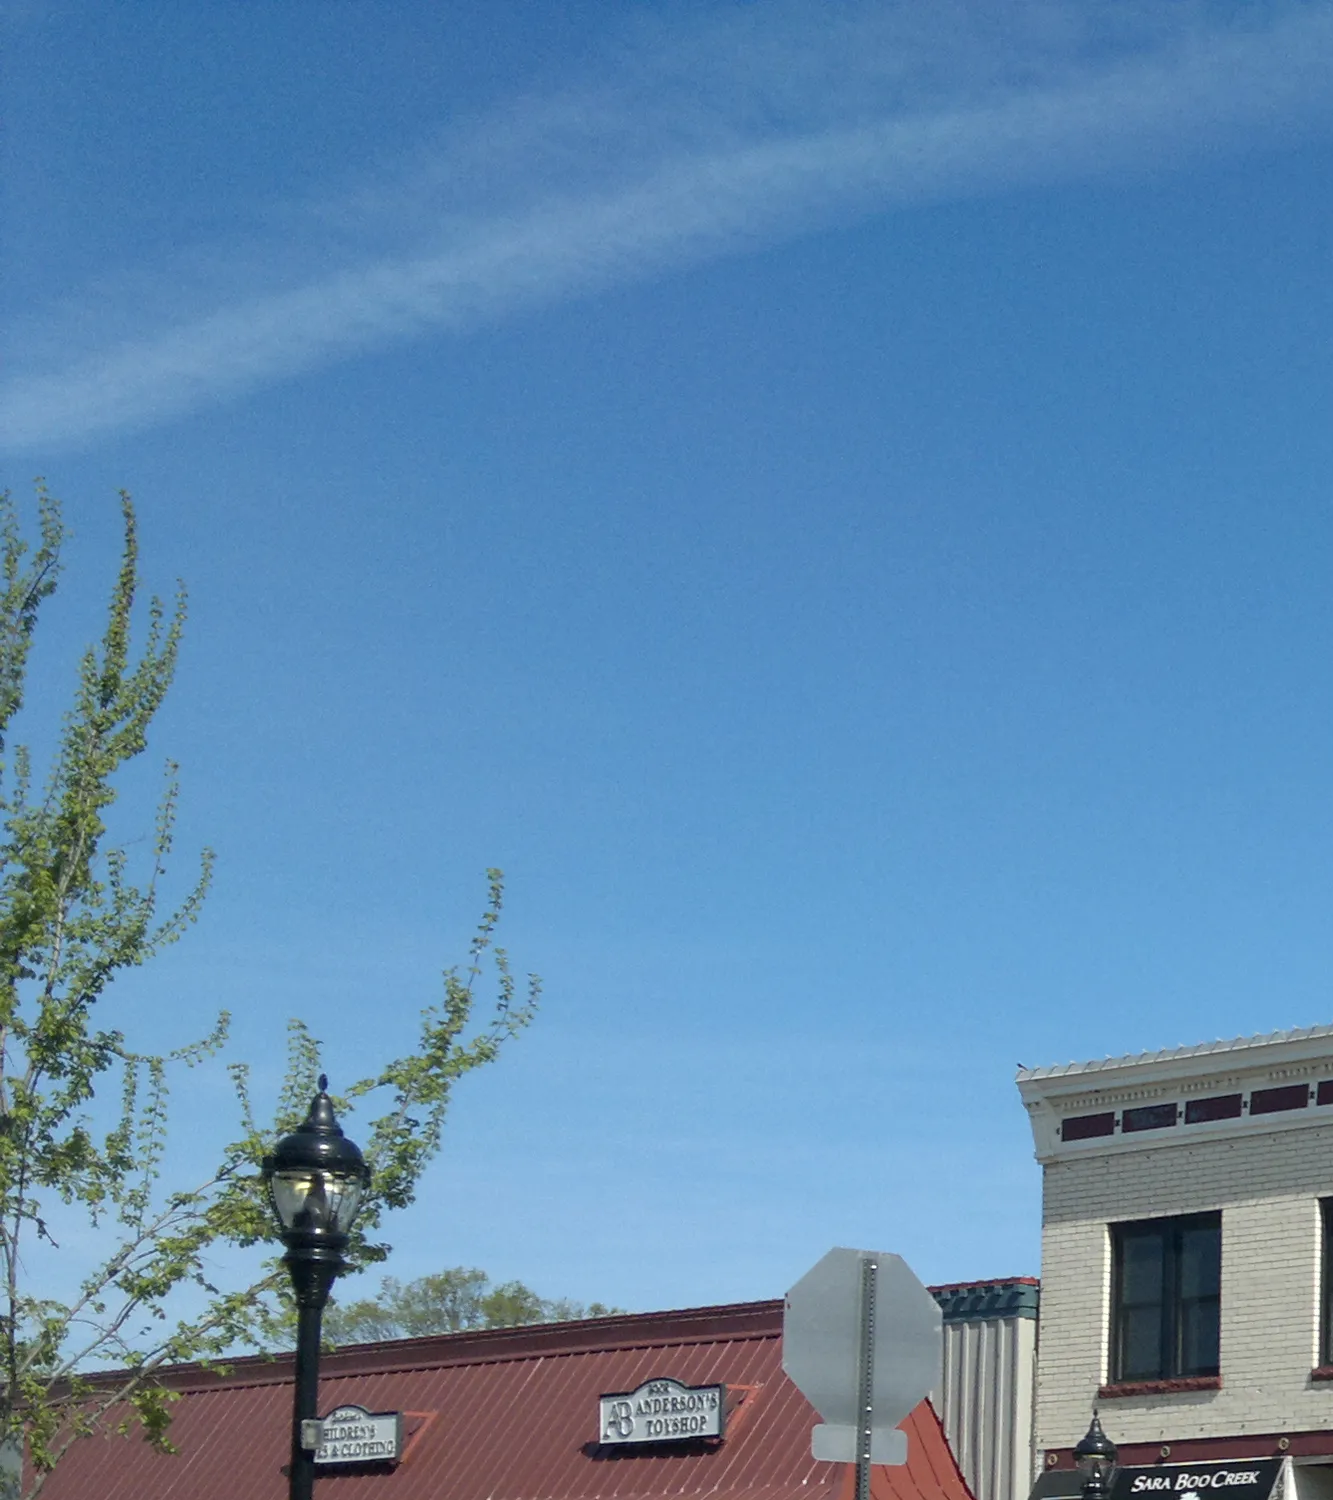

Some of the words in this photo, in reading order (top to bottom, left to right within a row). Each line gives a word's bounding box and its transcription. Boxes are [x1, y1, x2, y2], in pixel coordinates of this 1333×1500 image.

[635, 1393, 718, 1417] ANDERSON'S
[323, 1424, 376, 1440] HILDREN'S
[645, 1415, 707, 1437] TOYSHOP
[341, 1440, 395, 1457] CLOTHING
[1130, 1475, 1171, 1493] SARA
